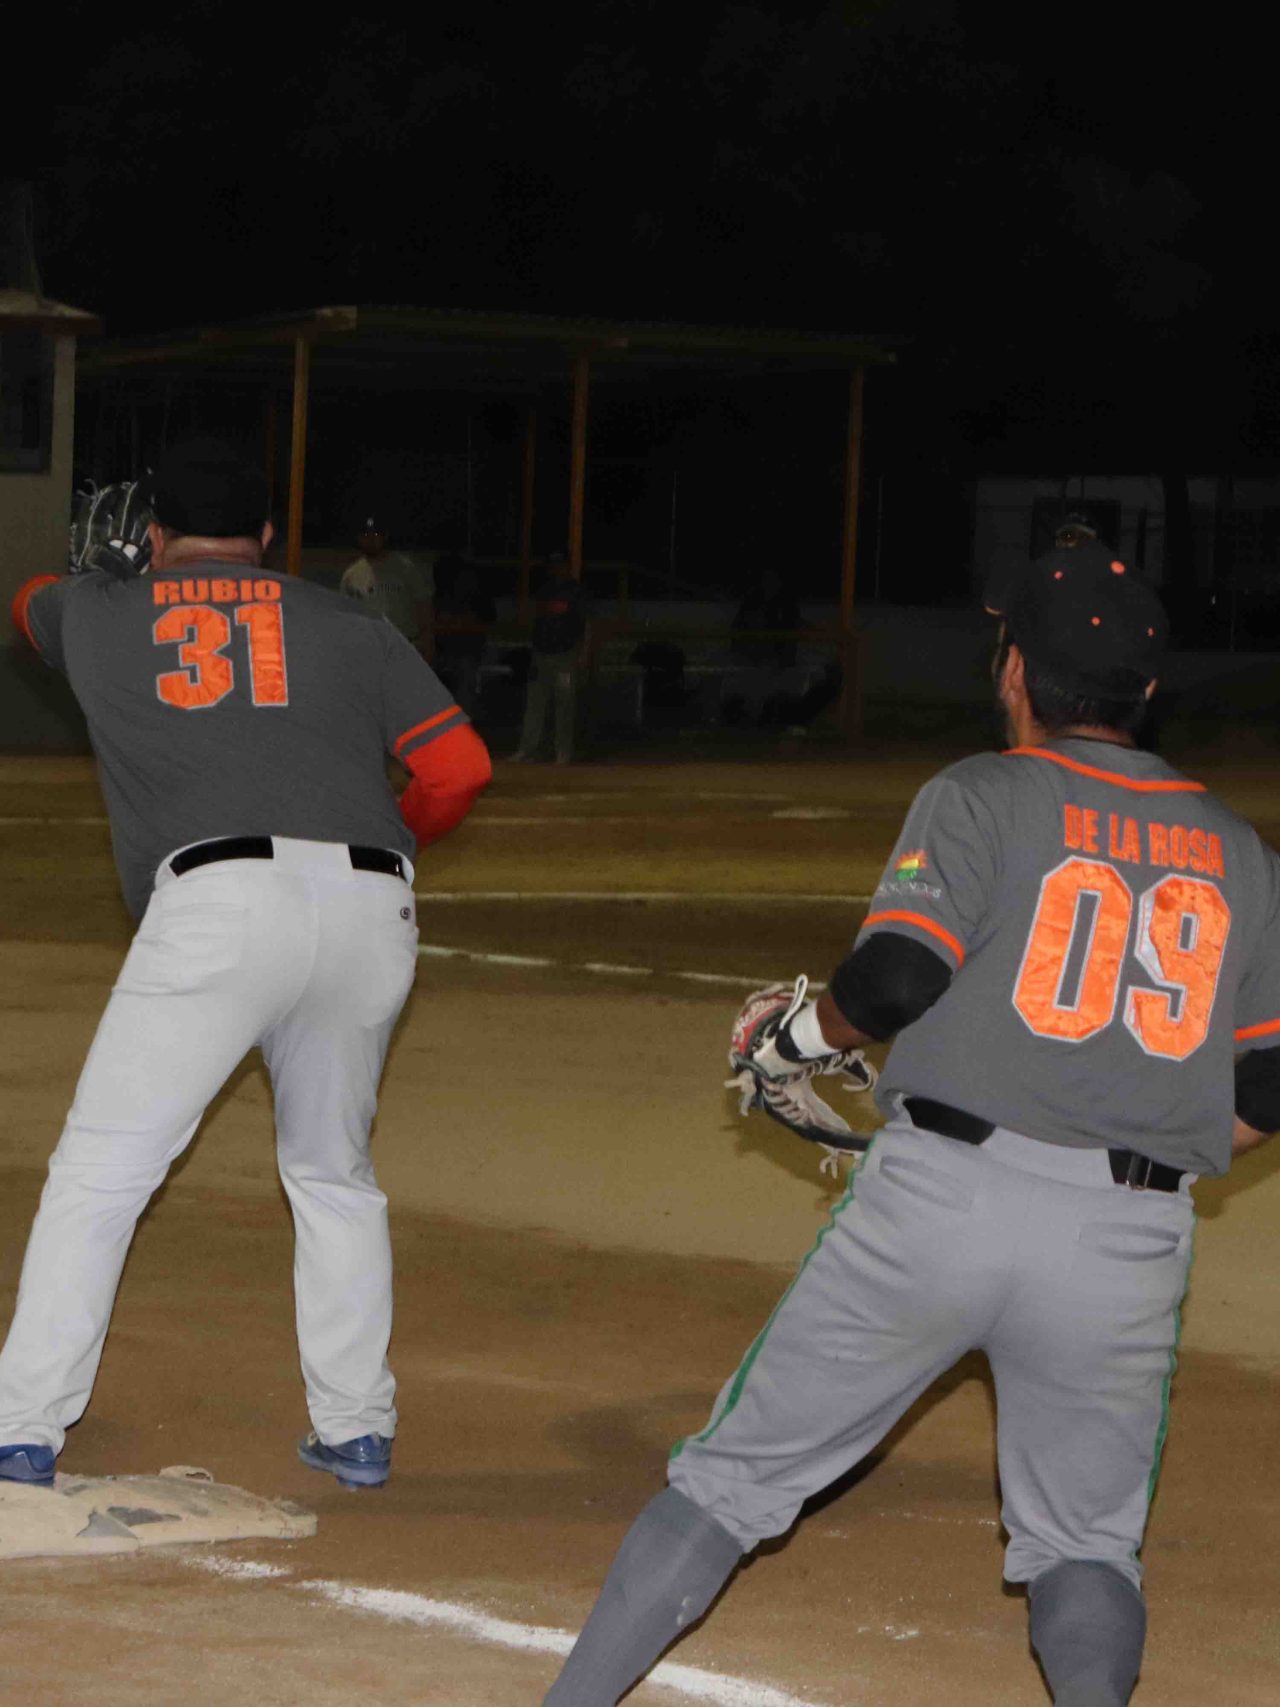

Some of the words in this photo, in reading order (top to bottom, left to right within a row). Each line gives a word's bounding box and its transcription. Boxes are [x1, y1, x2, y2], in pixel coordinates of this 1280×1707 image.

[153, 579, 281, 605] RUBIO
[152, 602, 288, 709] 31
[1064, 803, 1099, 853] DE
[1109, 812, 1141, 864] LA
[1149, 821, 1224, 880] ROSA
[1012, 855, 1231, 1062] 09
